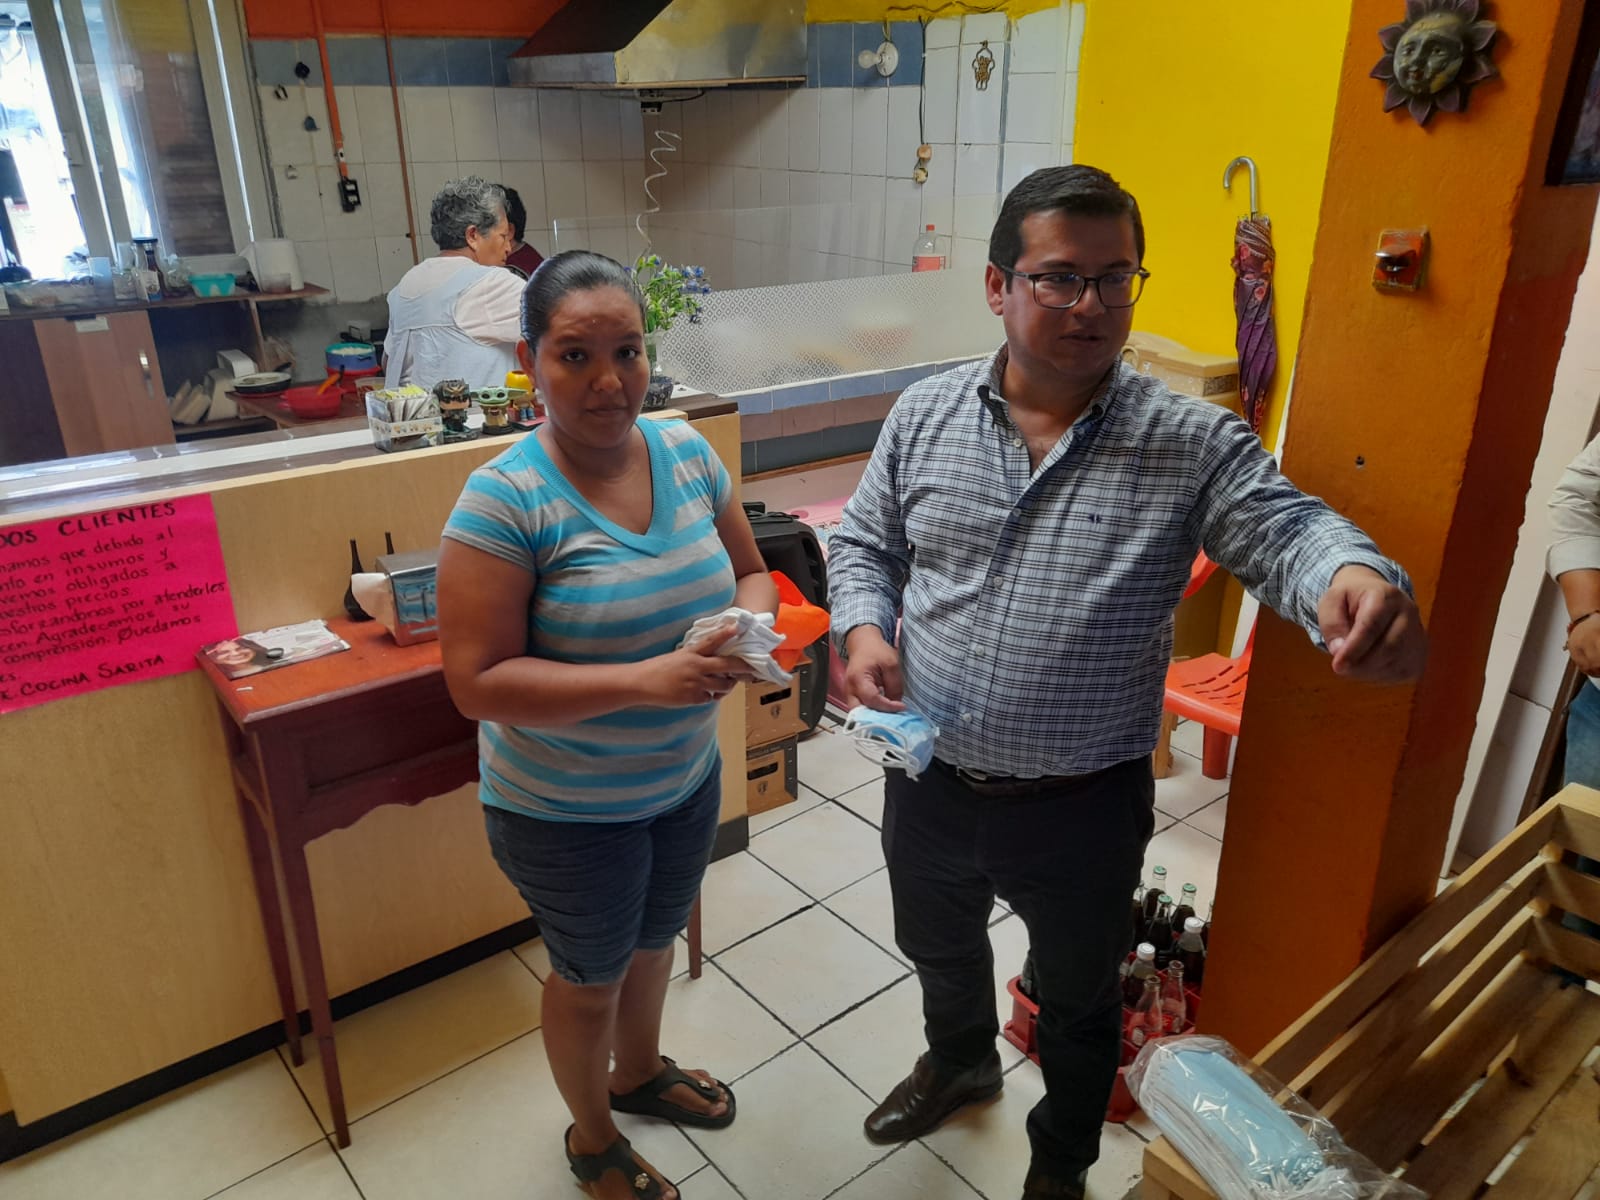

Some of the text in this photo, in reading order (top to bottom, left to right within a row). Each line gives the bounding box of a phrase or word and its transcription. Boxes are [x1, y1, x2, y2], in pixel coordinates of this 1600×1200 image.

[58, 502, 176, 536] CLIENTES
[60, 549, 85, 564] que
[93, 534, 144, 553] debido
[156, 525, 174, 540] al
[65, 554, 145, 576] insumos
[66, 568, 149, 591] obligados
[65, 587, 129, 610] precios
[122, 600, 144, 614] por
[36, 611, 155, 646] Agradecemos
[118, 615, 201, 645] Quedamos
[20, 672, 91, 696] COCINA
[97, 655, 165, 679] SARITA
